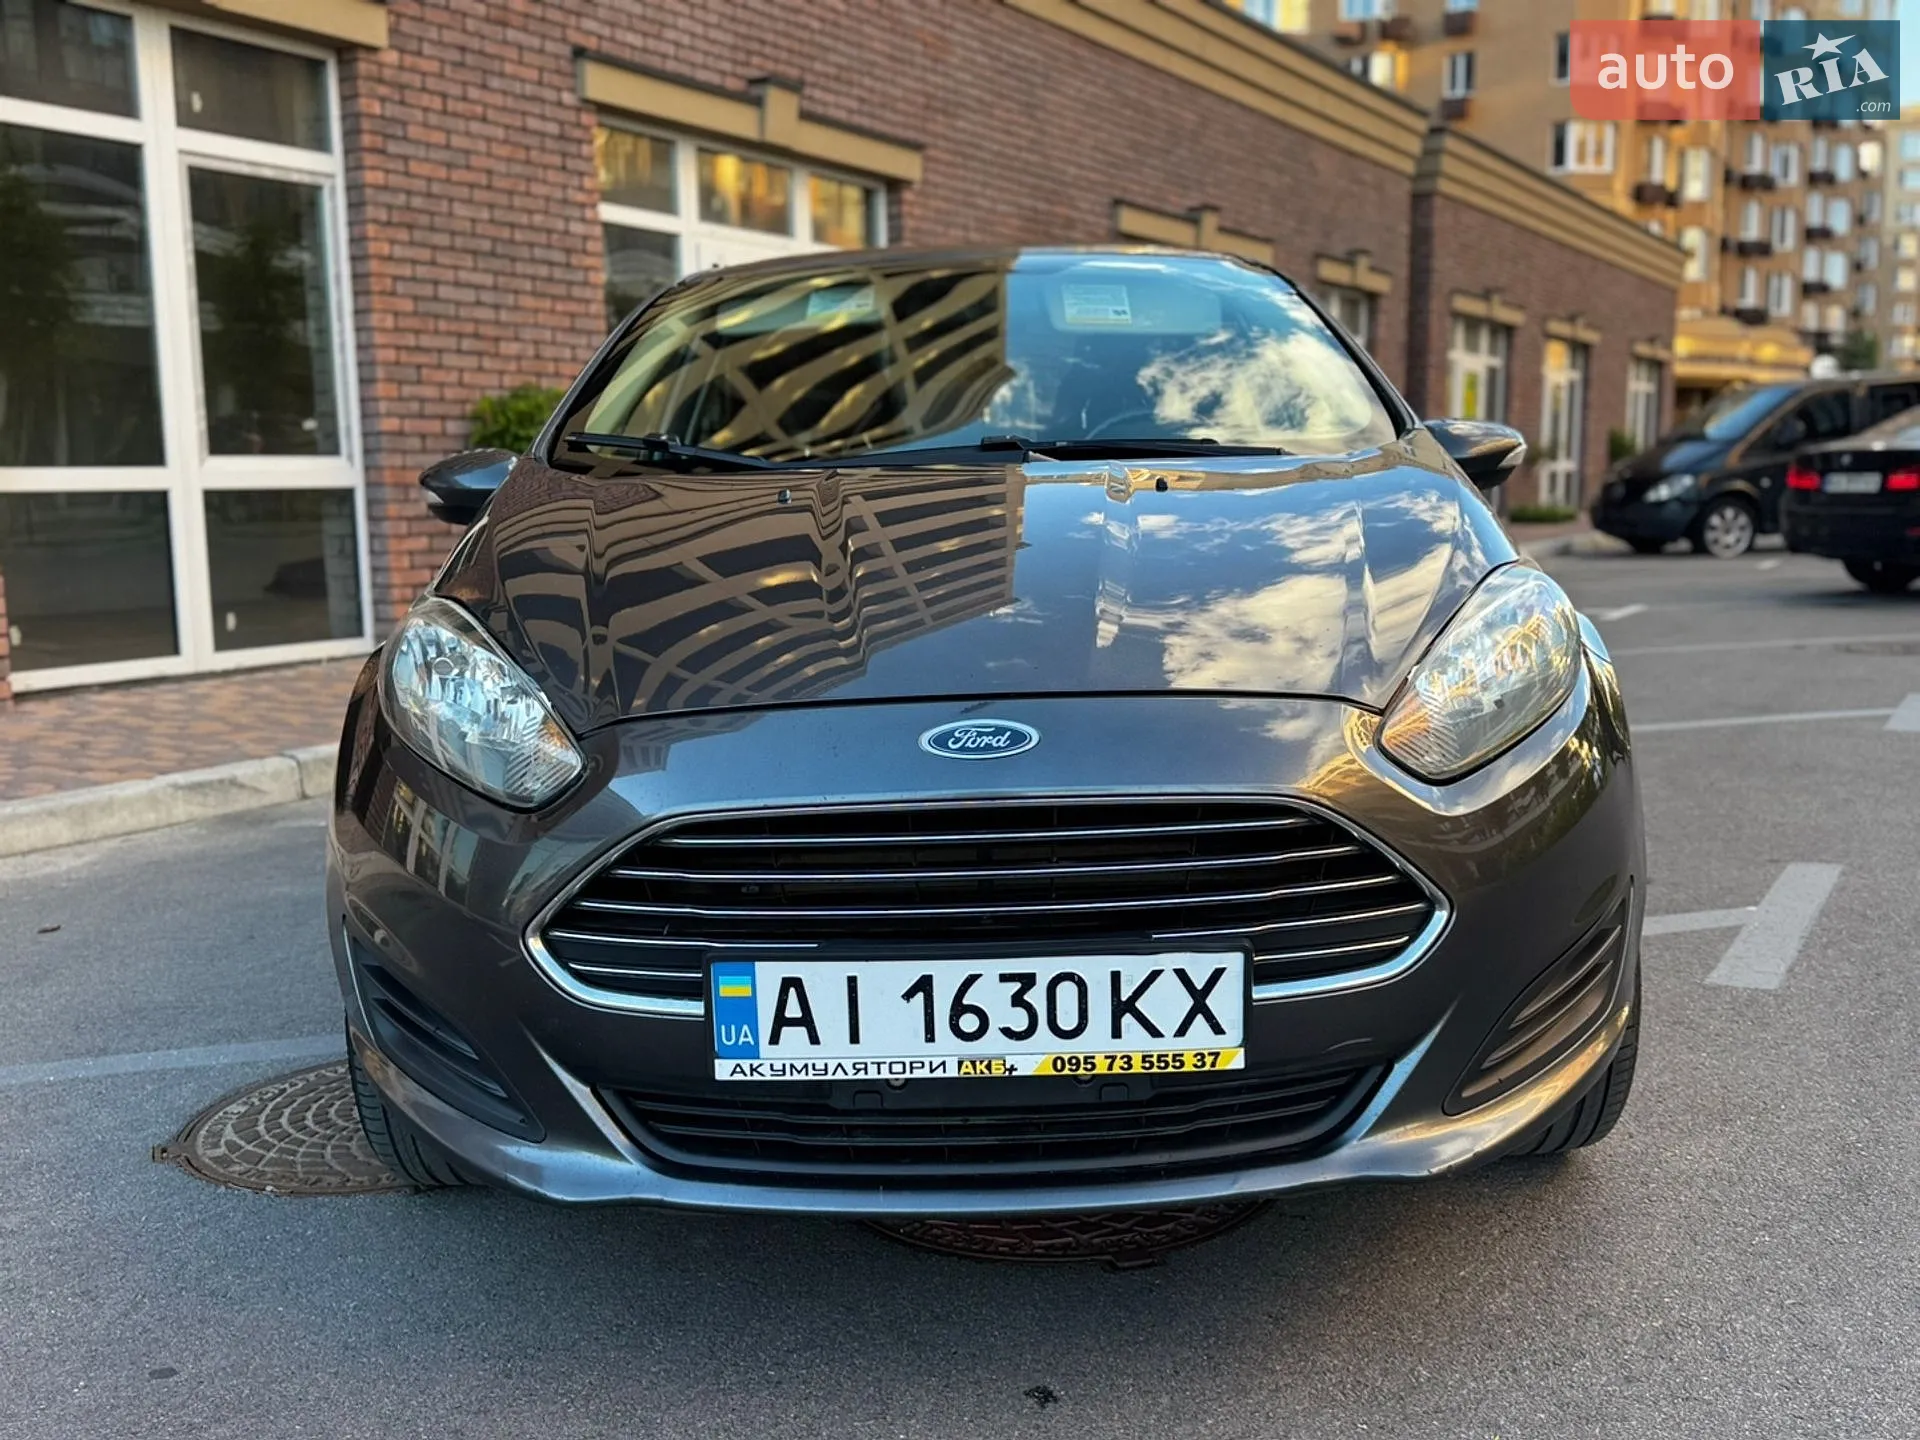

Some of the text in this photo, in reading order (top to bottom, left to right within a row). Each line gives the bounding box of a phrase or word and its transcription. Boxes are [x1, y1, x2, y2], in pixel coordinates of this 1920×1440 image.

[947, 726, 1012, 750] Ford
[900, 970, 1091, 1044] 1630
[721, 1024, 755, 1047] UA
[729, 1060, 948, 1078] АКУМУЛЯТОРИ
[1051, 1051, 1221, 1073] 095 73 555 37
